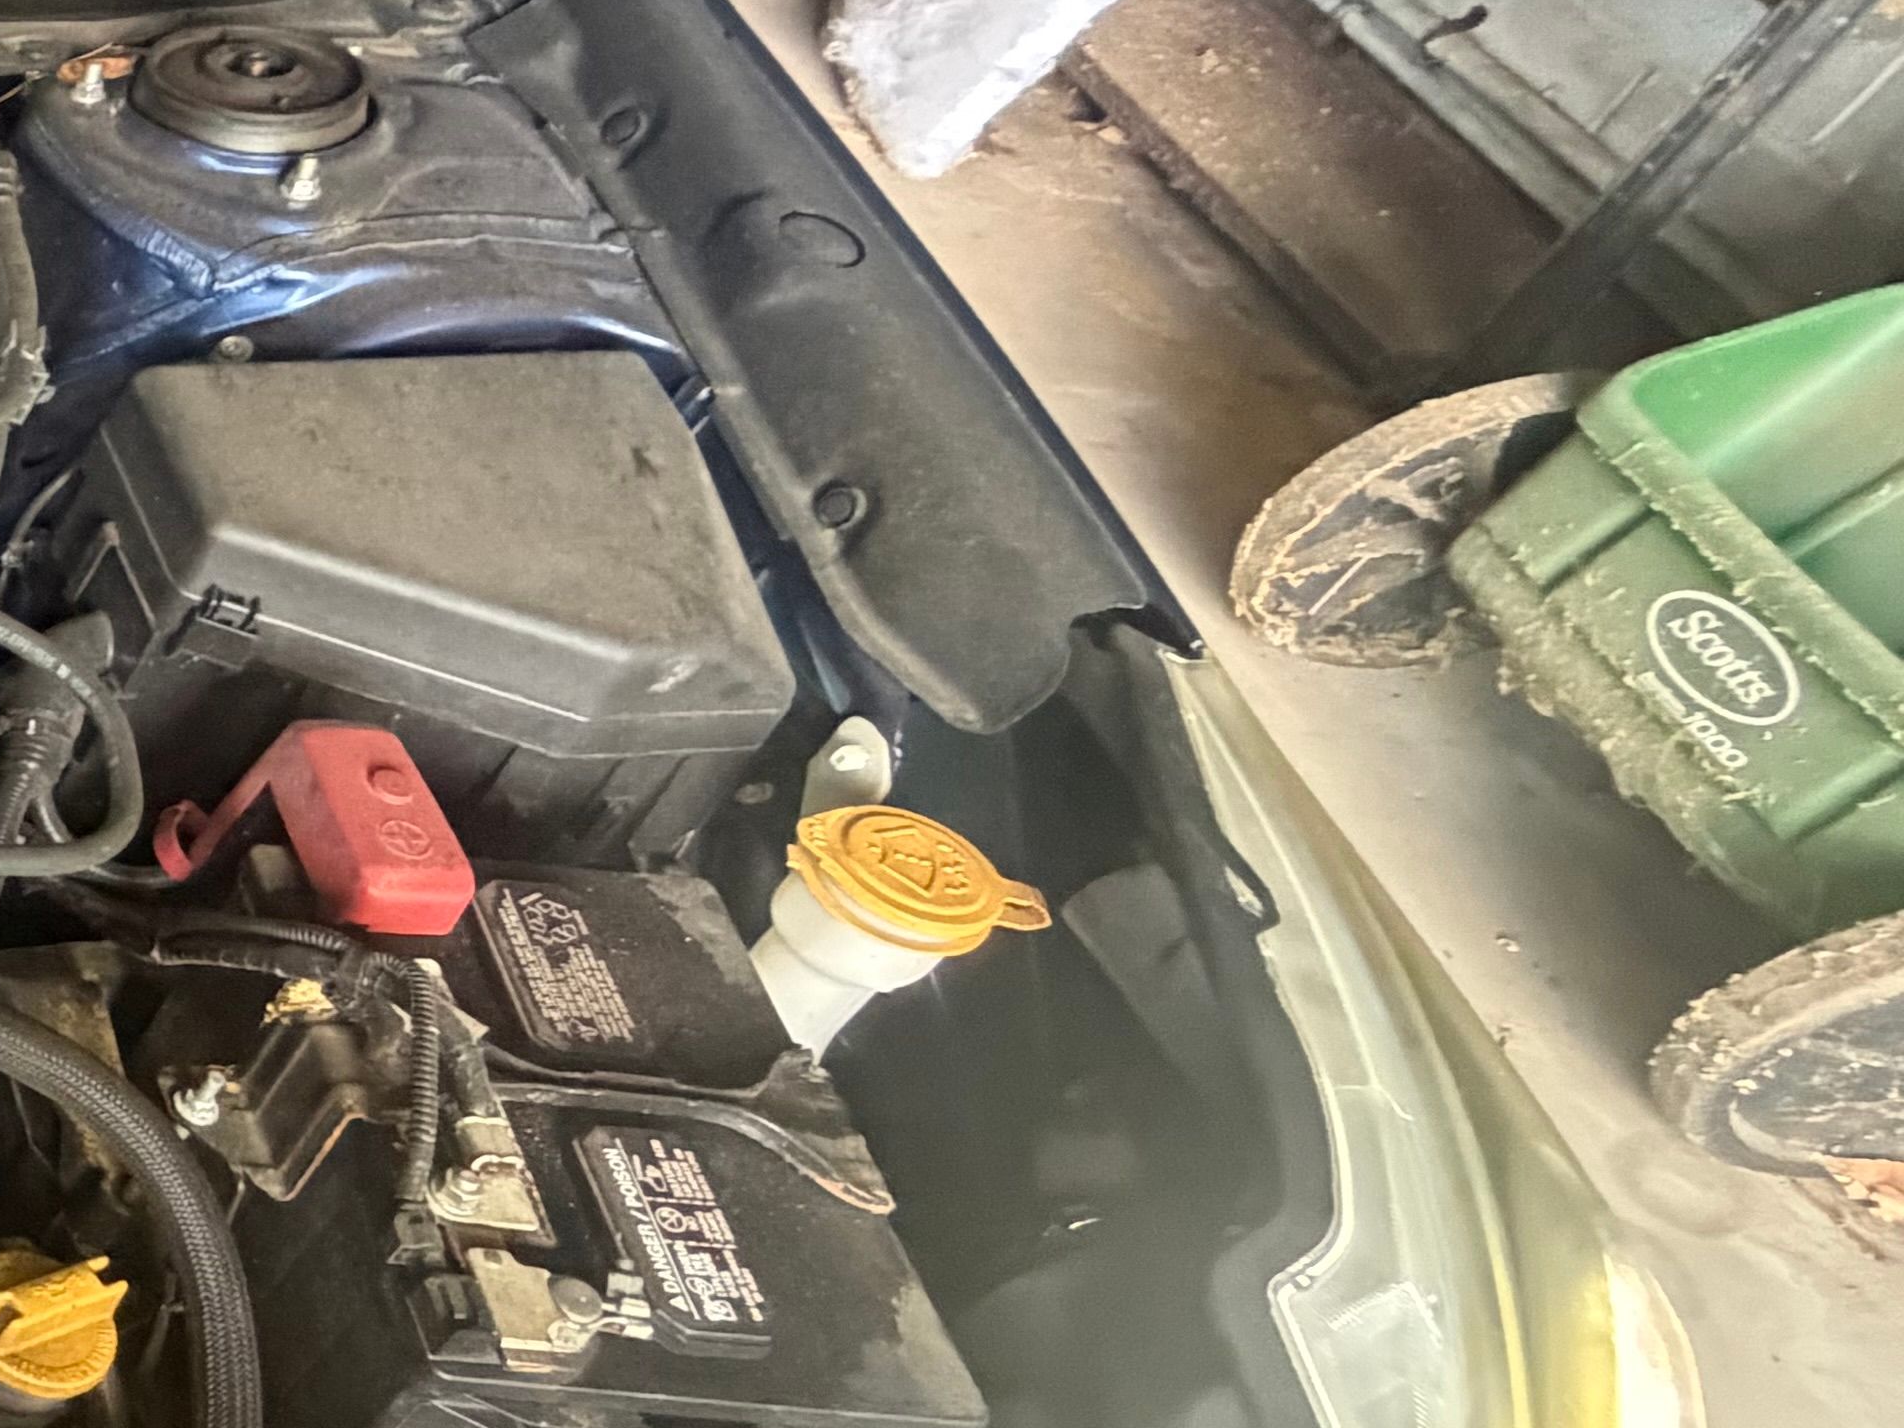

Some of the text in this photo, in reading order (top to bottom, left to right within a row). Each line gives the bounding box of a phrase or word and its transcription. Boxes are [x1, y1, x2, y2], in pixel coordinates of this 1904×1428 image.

[1667, 610, 1777, 705] Scotts
[1682, 711, 1749, 764] 1000
[602, 1147, 644, 1208] POISON
[637, 1223, 681, 1294] DANGER
